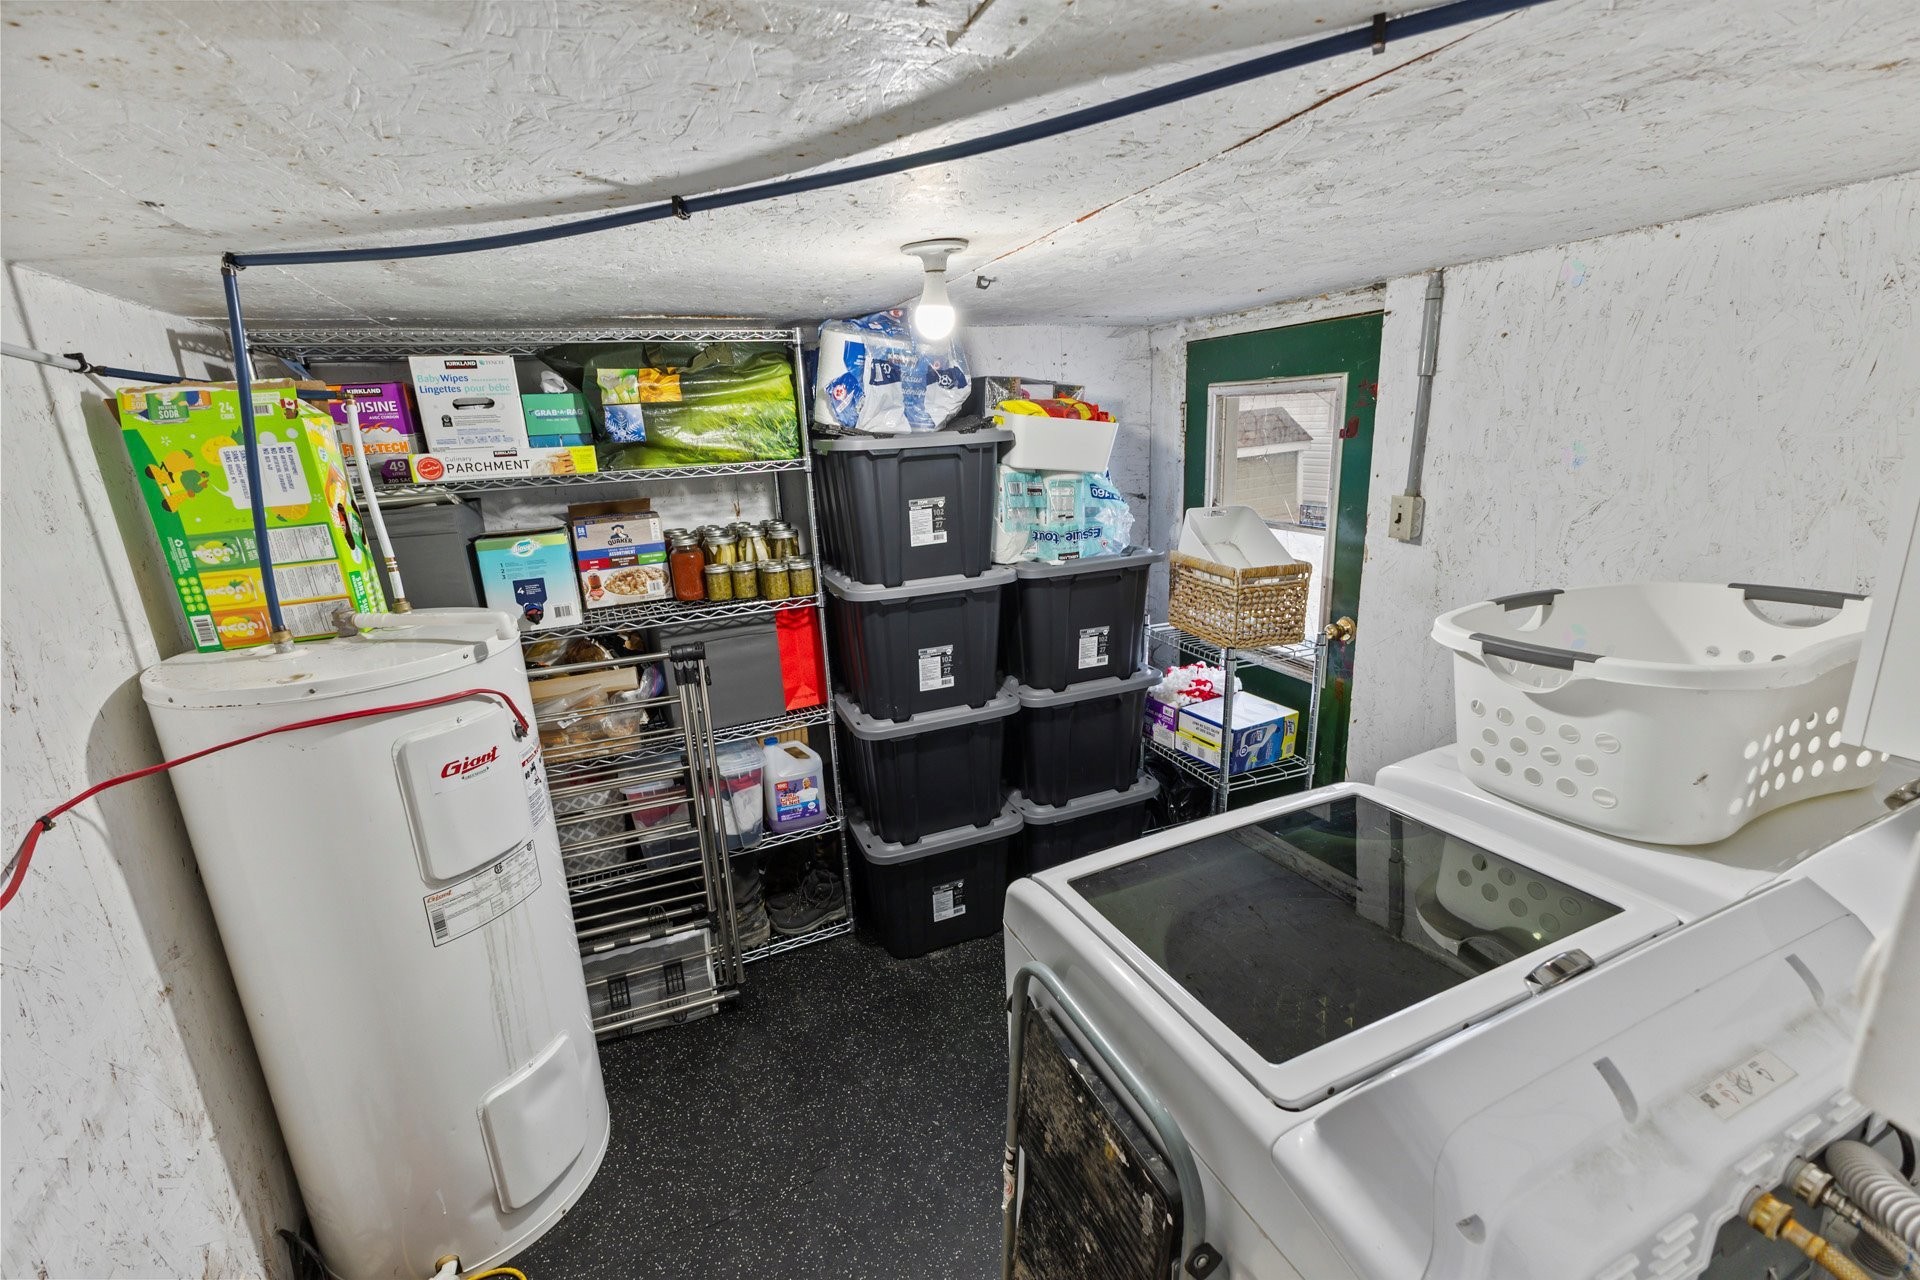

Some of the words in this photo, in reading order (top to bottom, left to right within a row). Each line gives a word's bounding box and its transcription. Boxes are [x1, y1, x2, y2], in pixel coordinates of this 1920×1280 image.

[419, 385, 462, 395] Lingettes
[464, 384, 486, 394] pour
[489, 383, 511, 392] bébé
[218, 402, 234, 413] 24
[158, 409, 180, 419] SODA
[341, 441, 410, 457] FLX-TECH
[389, 461, 406, 471] 49
[444, 456, 472, 465] Culinary
[446, 459, 531, 474] PARCHMENT
[608, 538, 632, 546] QUAKER
[517, 587, 525, 595] 4
[441, 745, 501, 779] Giant
[427, 889, 453, 903] Giant
